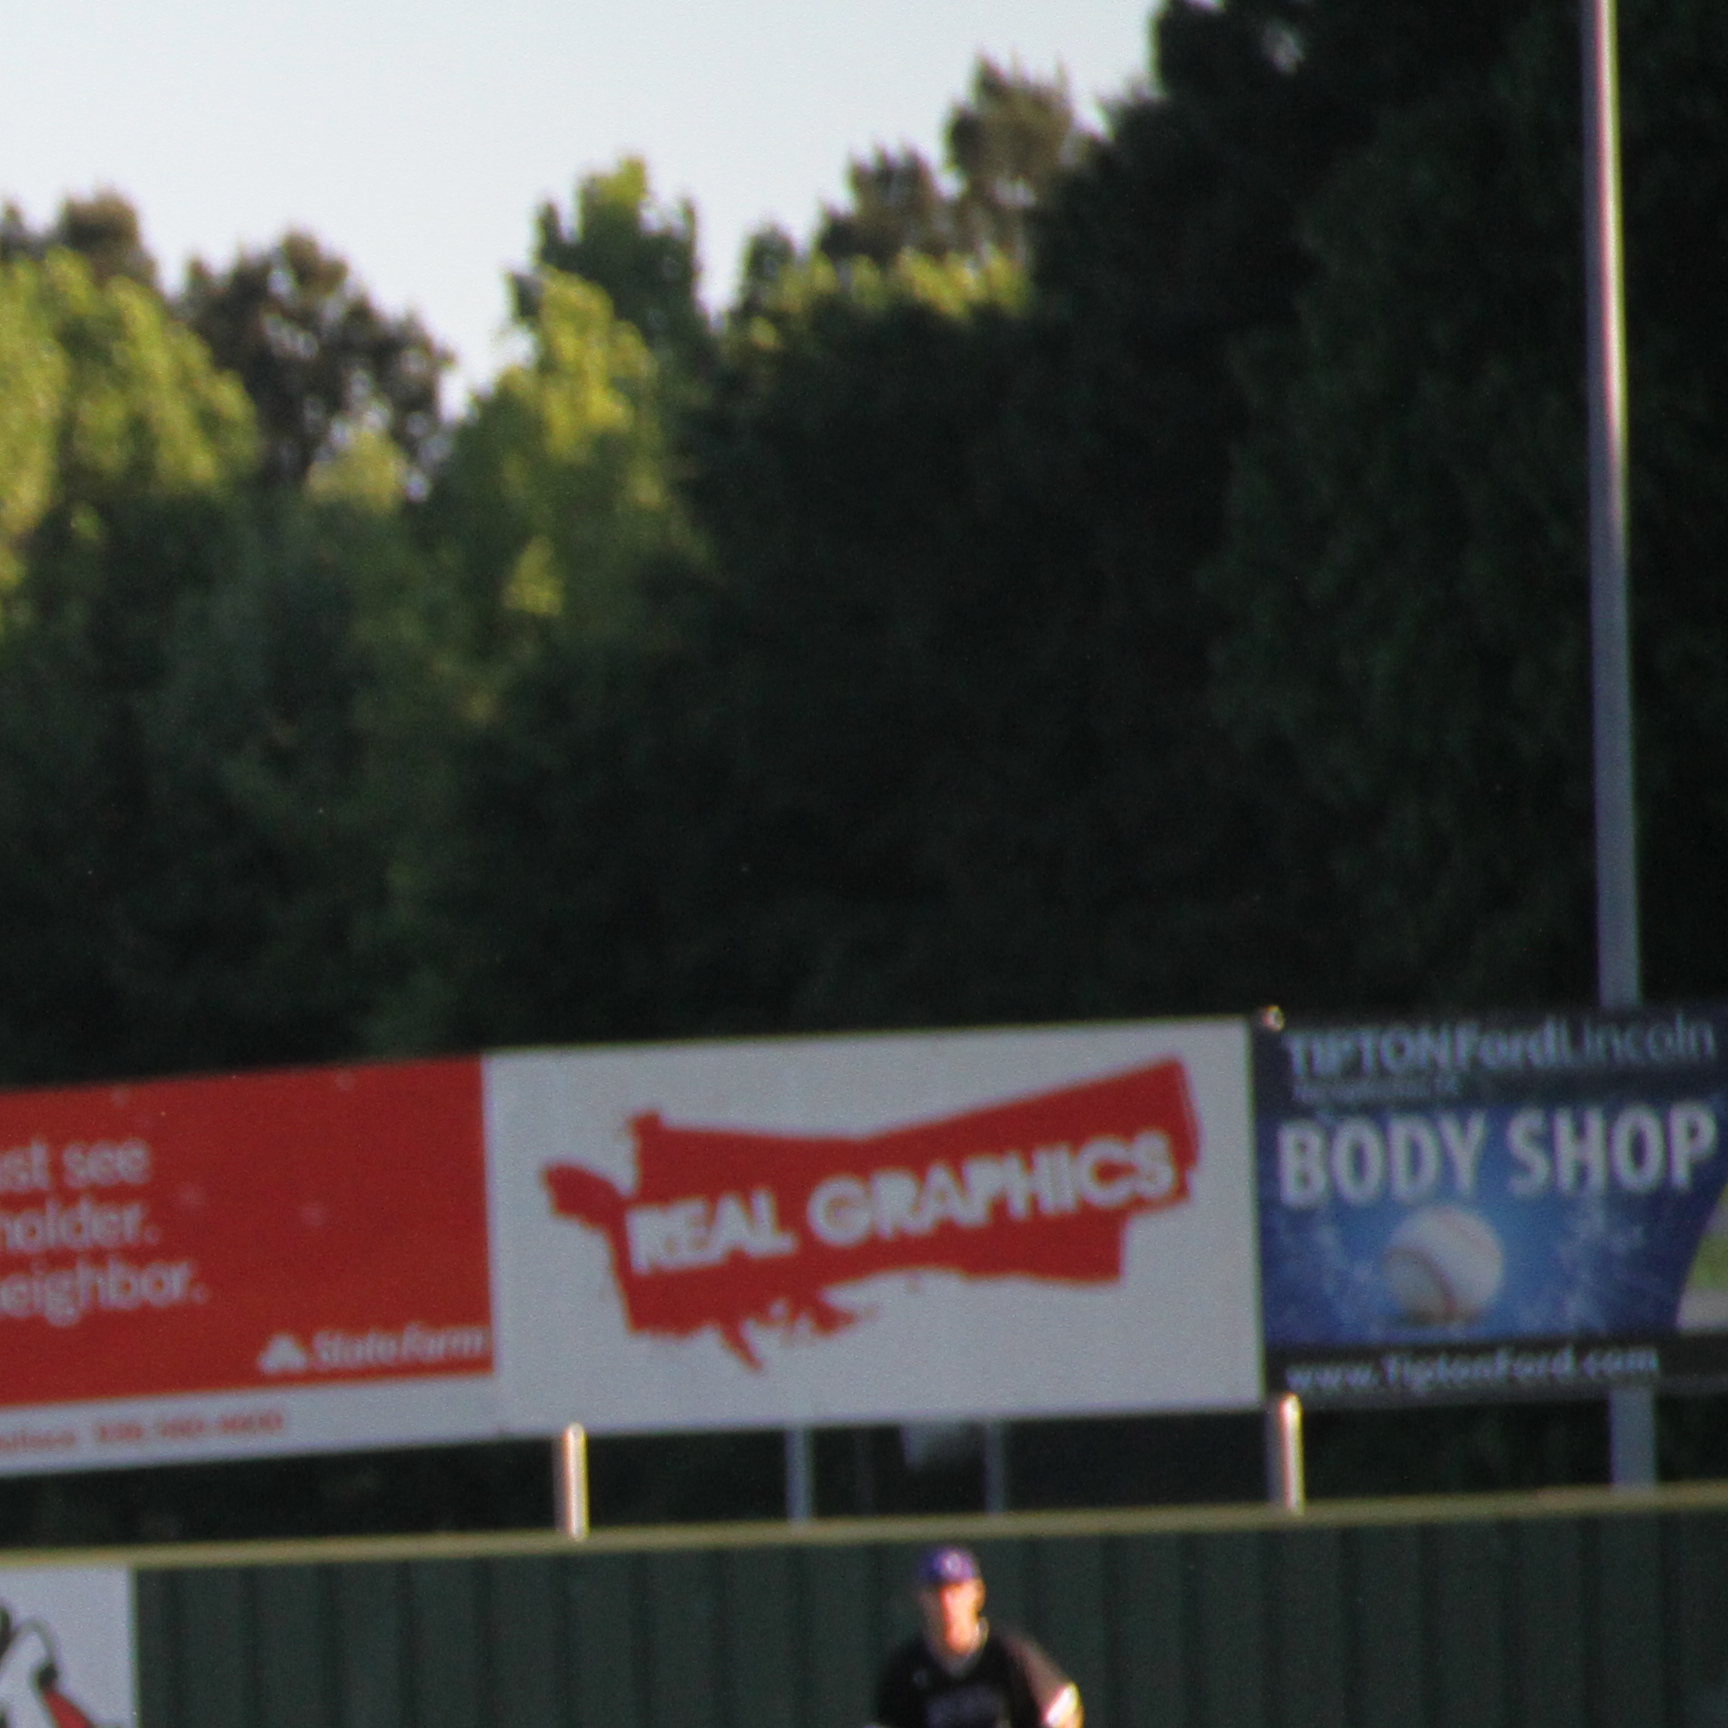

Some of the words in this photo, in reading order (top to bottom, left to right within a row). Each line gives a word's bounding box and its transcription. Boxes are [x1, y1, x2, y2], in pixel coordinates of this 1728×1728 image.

[62, 1138, 151, 1188] see
[625, 1189, 798, 1275] REAL
[806, 1129, 1178, 1248] GRAPHICS
[1276, 1111, 1486, 1209] BODY
[1506, 1104, 1718, 1196] SHOP
